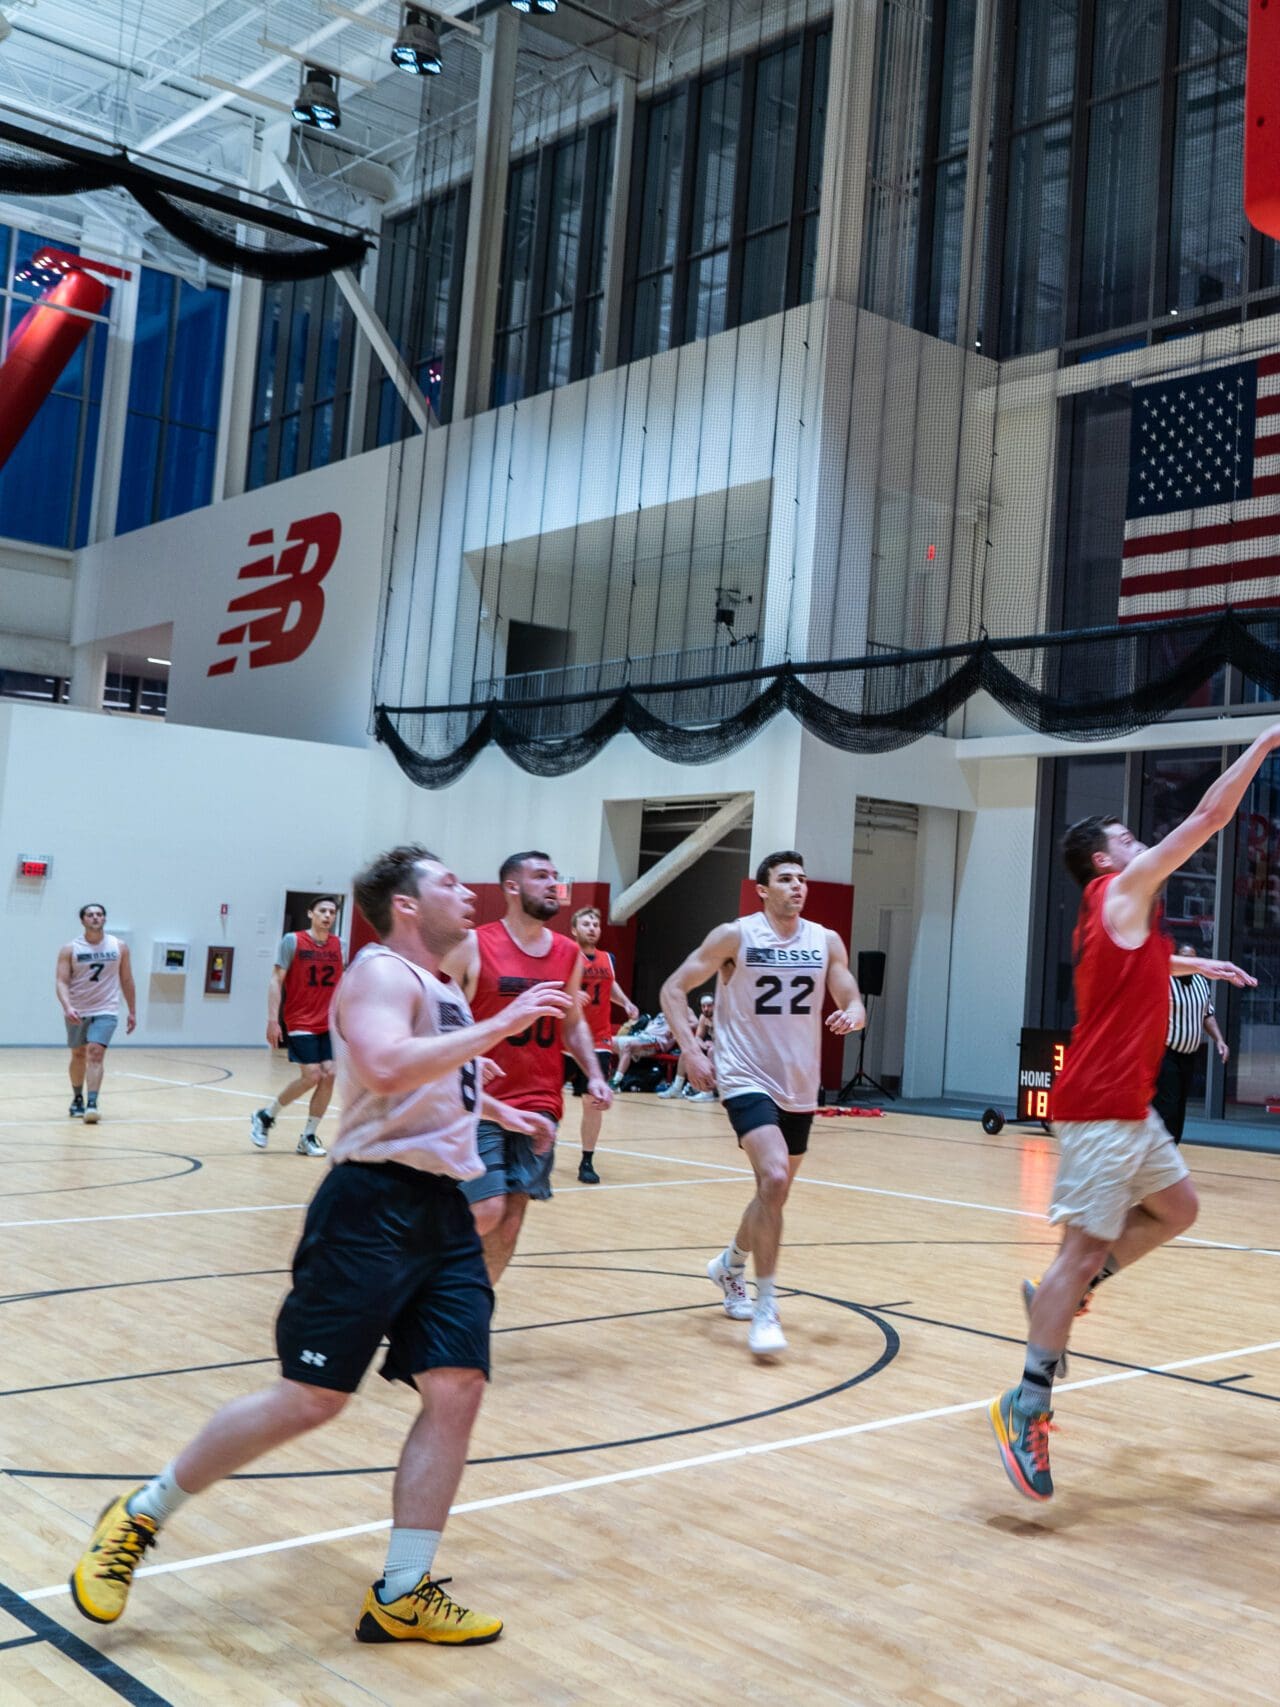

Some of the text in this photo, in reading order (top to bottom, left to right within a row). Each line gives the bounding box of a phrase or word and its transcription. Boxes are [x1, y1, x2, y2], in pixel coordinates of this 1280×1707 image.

[778, 950, 823, 961] BSSC
[90, 963, 104, 982] 7
[308, 965, 336, 987] 12
[755, 975, 815, 1015] 22
[1020, 1070, 1052, 1089] HOME
[1027, 1090, 1049, 1118] 18
